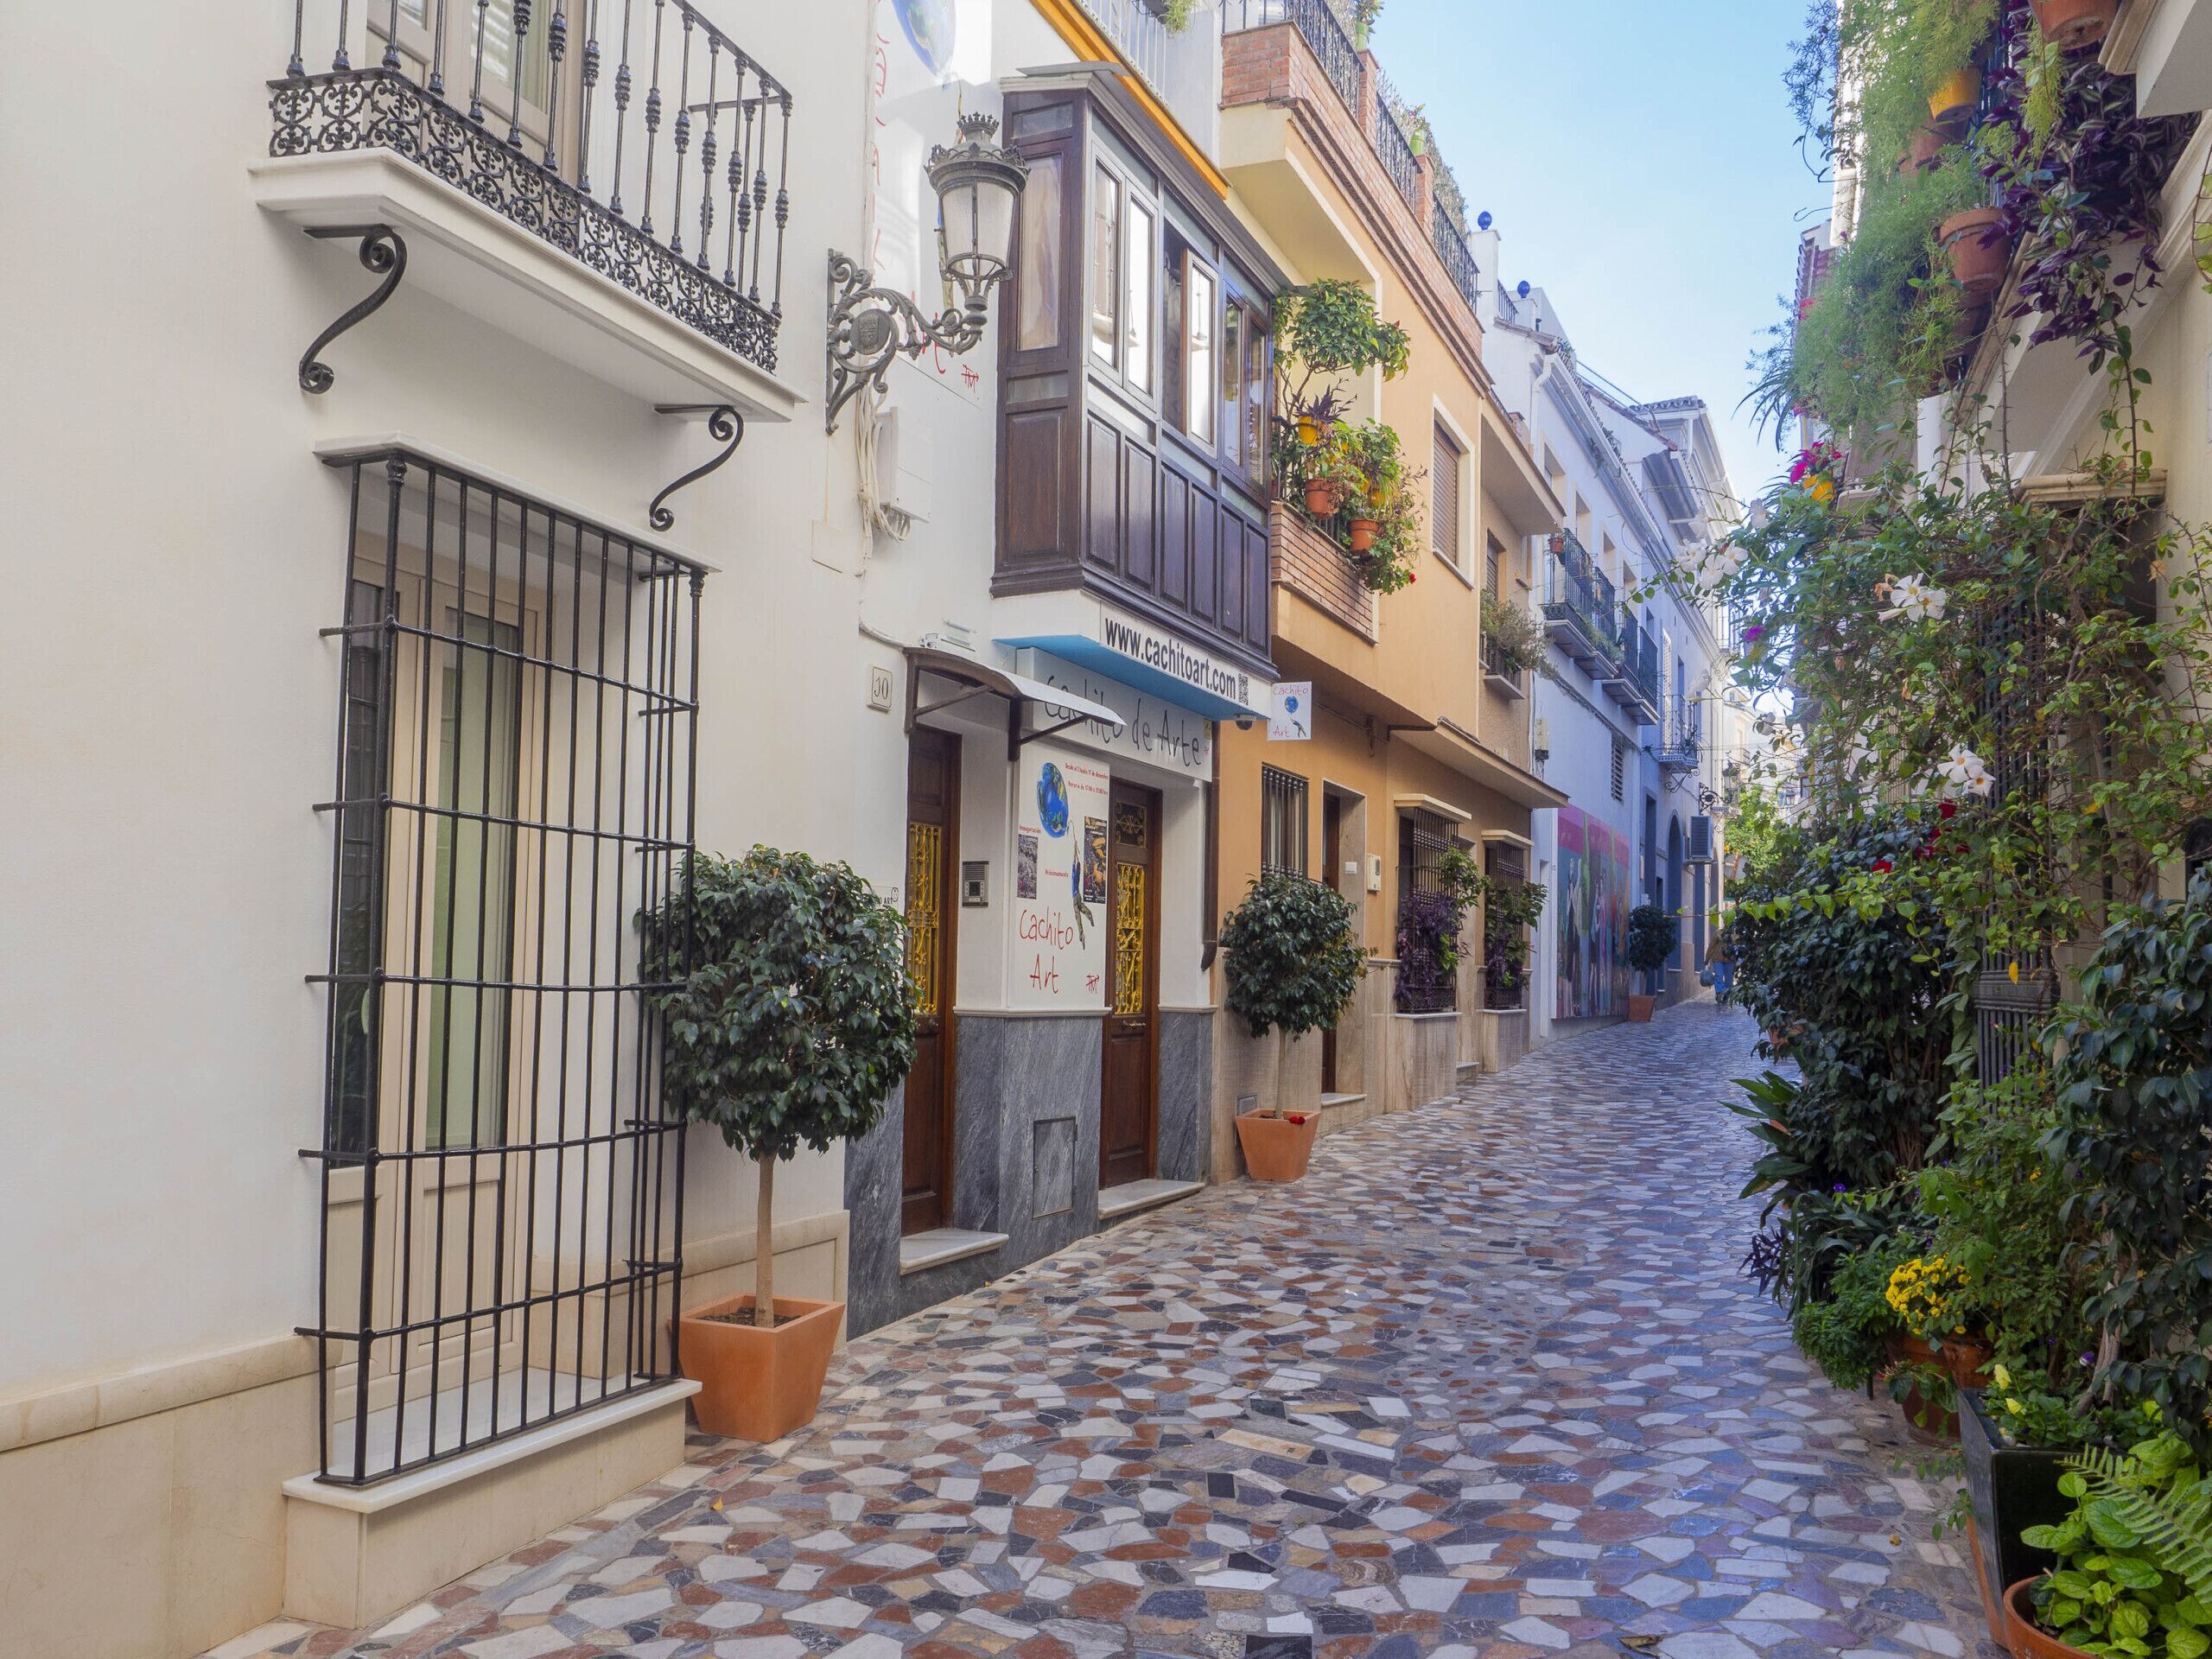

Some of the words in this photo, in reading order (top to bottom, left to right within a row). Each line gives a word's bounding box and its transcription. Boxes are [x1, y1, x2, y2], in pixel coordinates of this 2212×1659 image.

[1105, 618, 1236, 700] www.cachitoart.com
[1273, 684, 1308, 696] Cachito
[1132, 698, 1153, 751] de
[1157, 709, 1202, 767] Arte
[1273, 725, 1290, 738] Art
[1020, 906, 1073, 950] Cachito
[1030, 954, 1058, 994] Art
